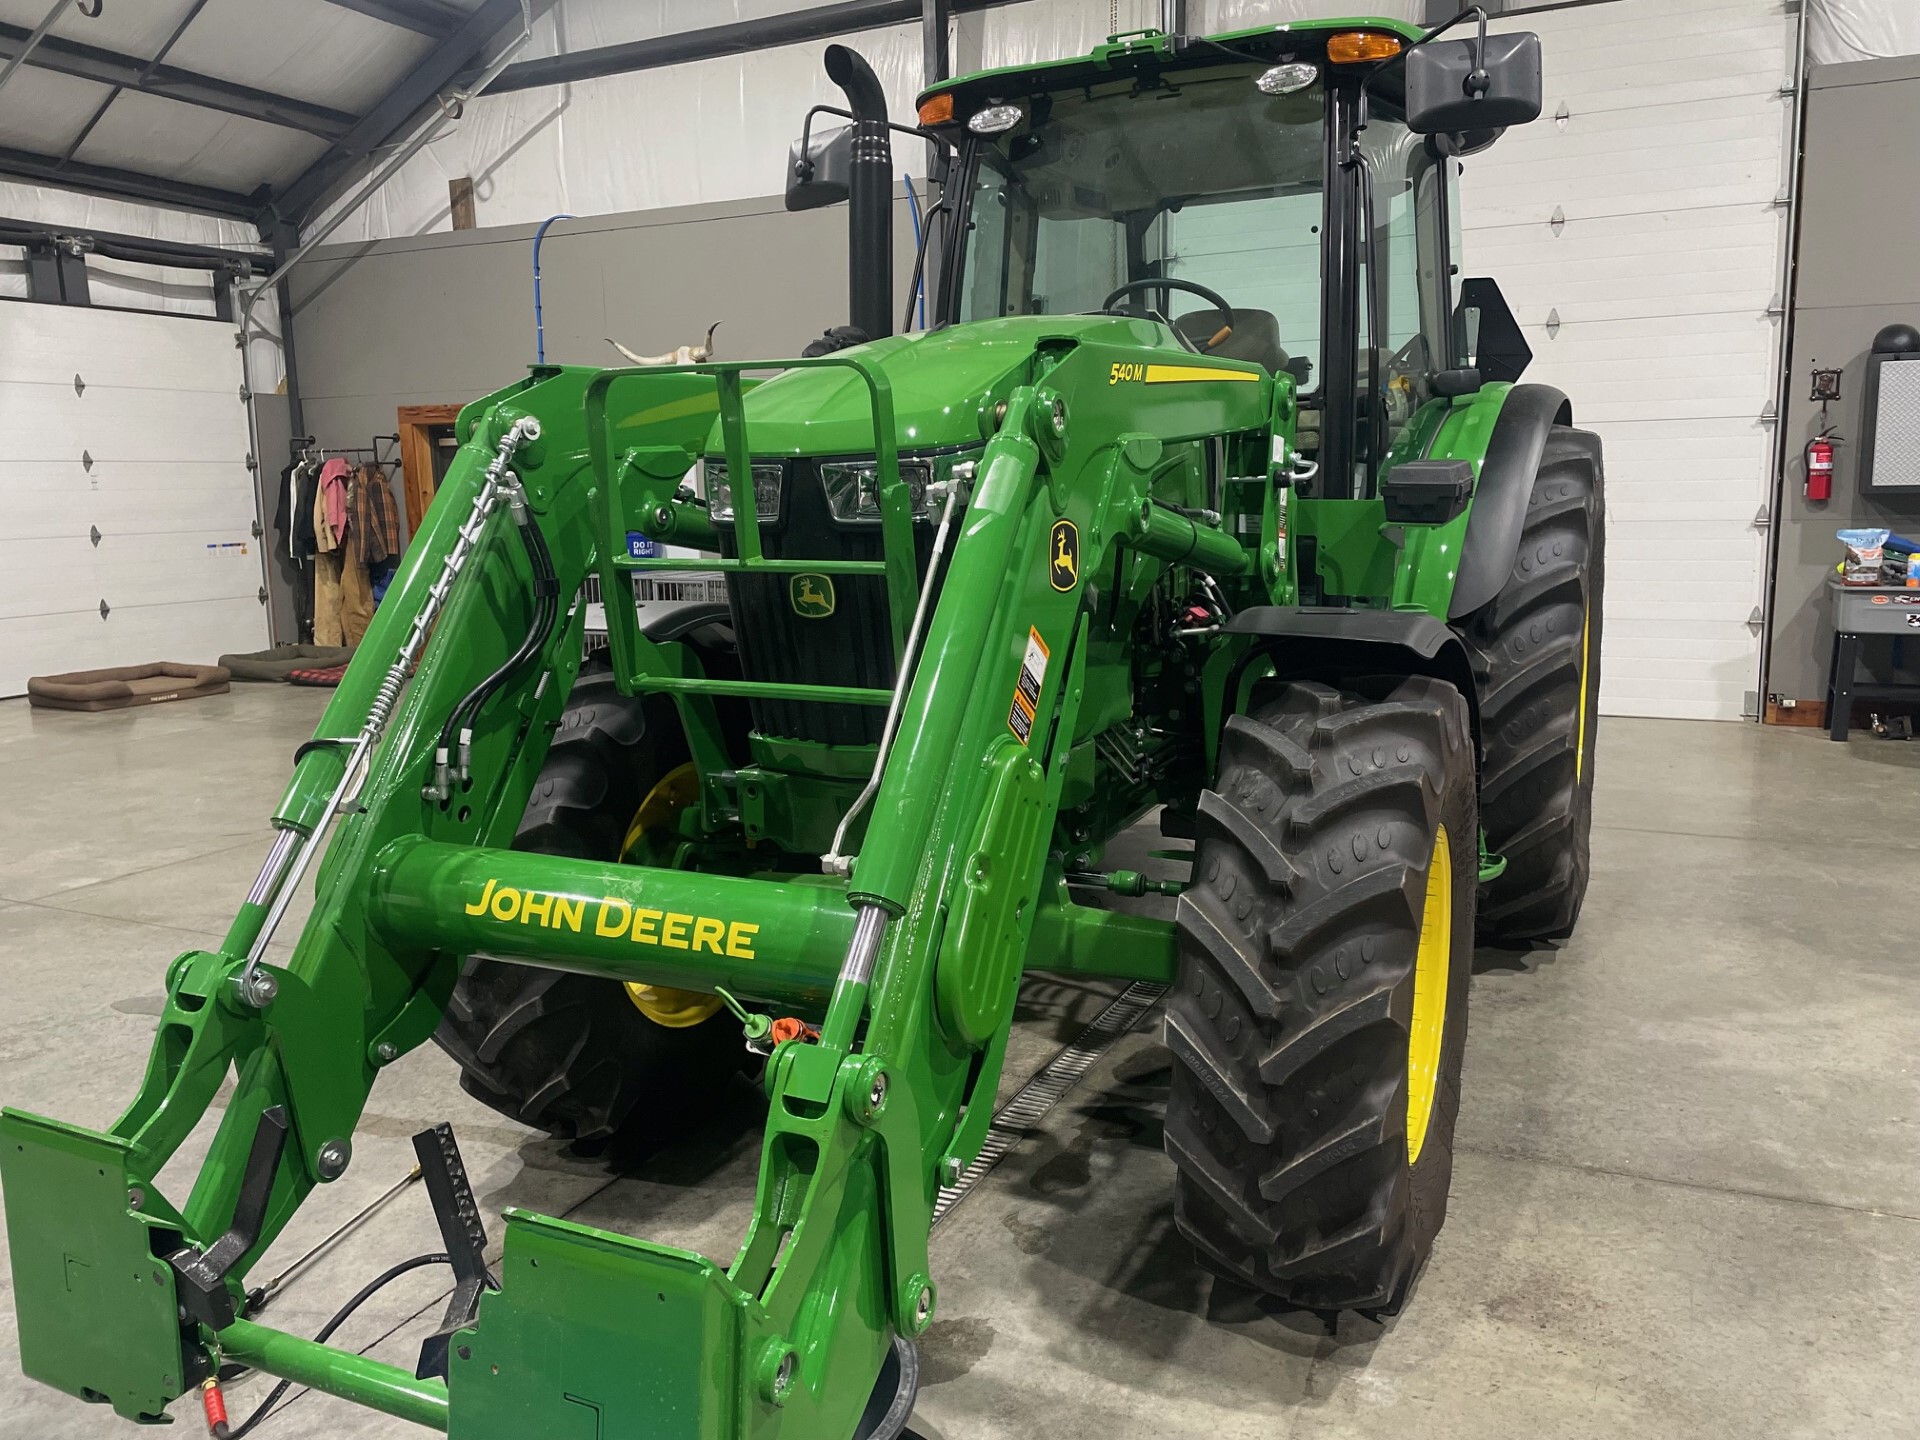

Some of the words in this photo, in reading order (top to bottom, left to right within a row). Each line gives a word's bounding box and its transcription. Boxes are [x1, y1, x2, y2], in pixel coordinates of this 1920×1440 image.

[633, 541, 645, 549] DO
[646, 541, 653, 549] IT
[465, 879, 587, 933] JOHN
[595, 896, 760, 960] DEERE
